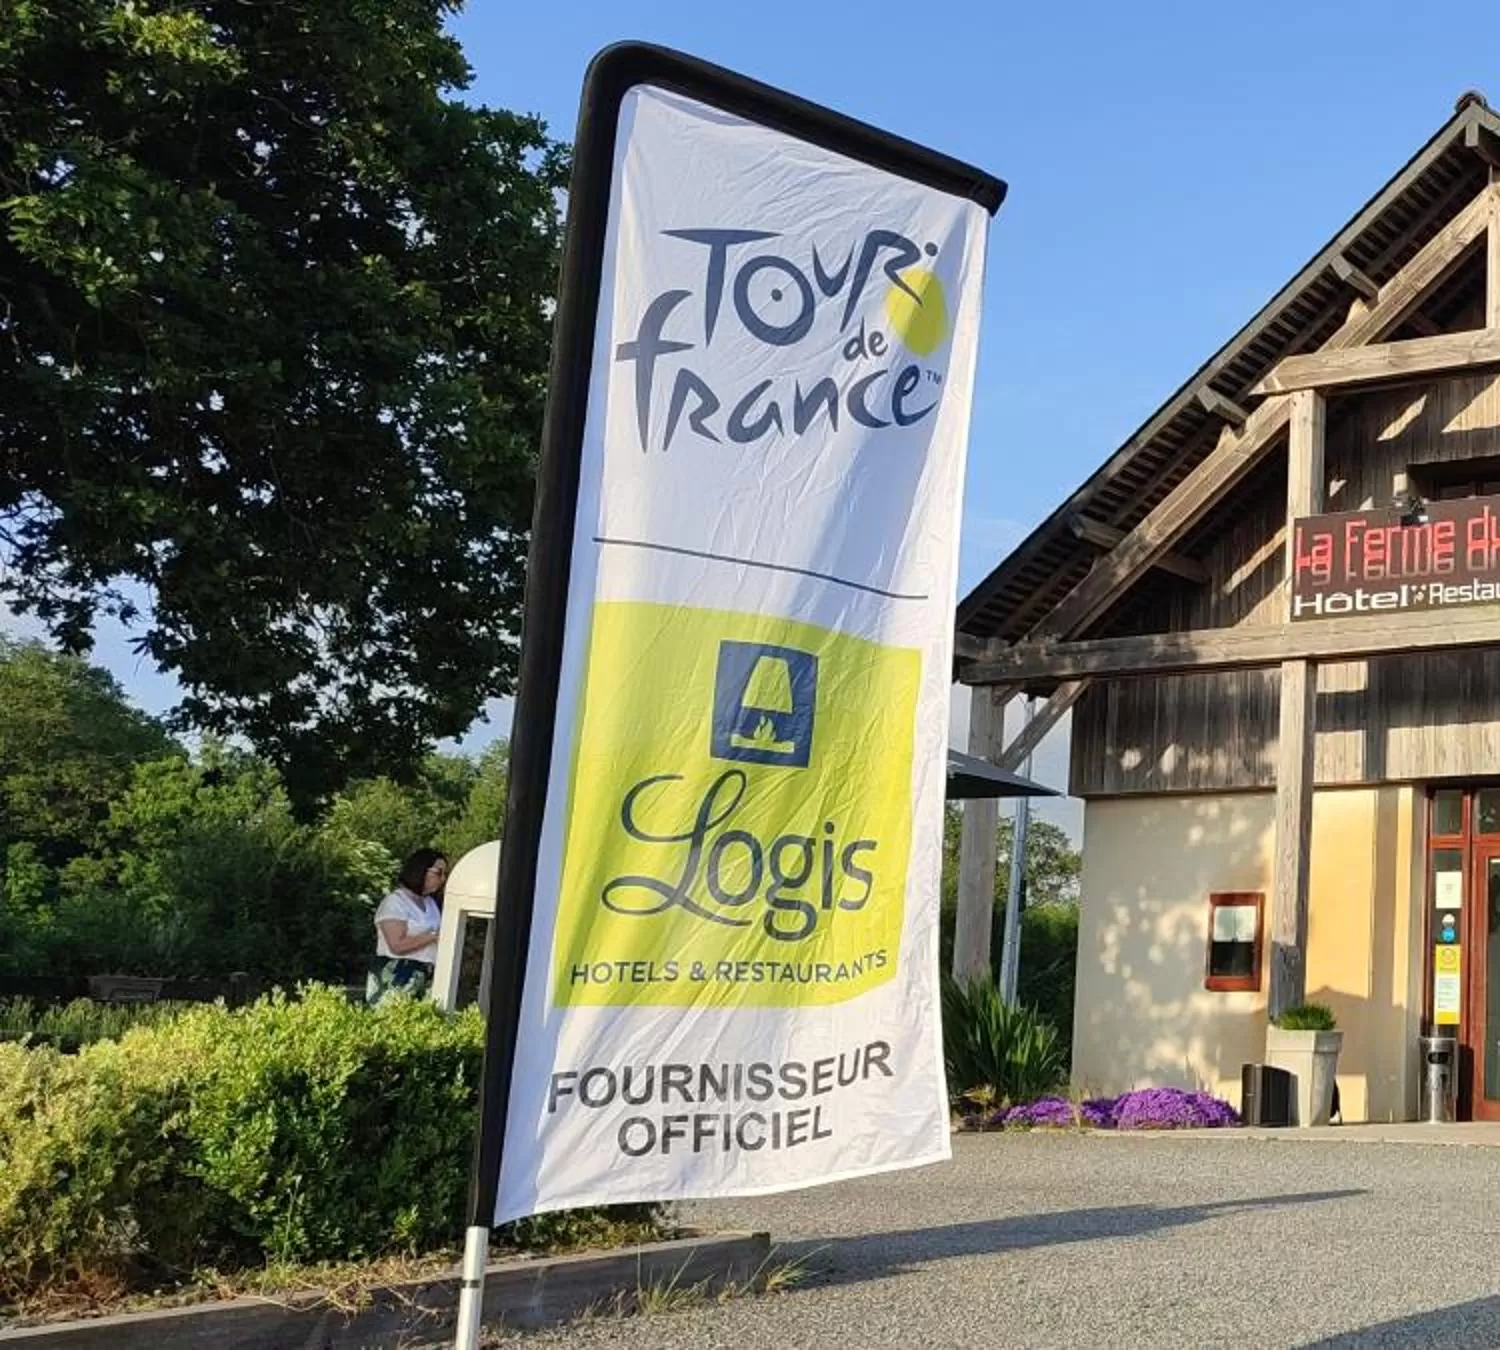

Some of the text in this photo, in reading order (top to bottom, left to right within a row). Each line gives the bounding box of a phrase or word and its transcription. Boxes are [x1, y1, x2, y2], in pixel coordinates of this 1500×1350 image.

[843, 316, 888, 361] de
[1295, 527, 1333, 567] La
[1345, 519, 1456, 560] Ferme
[1293, 584, 1409, 616] Hôtel
[602, 769, 878, 941] Logis
[571, 948, 888, 986] HOTELS & RESTAURANTS
[547, 1040, 895, 1114] FOURNISSEUR
[618, 1104, 833, 1158] OFFICIEL
